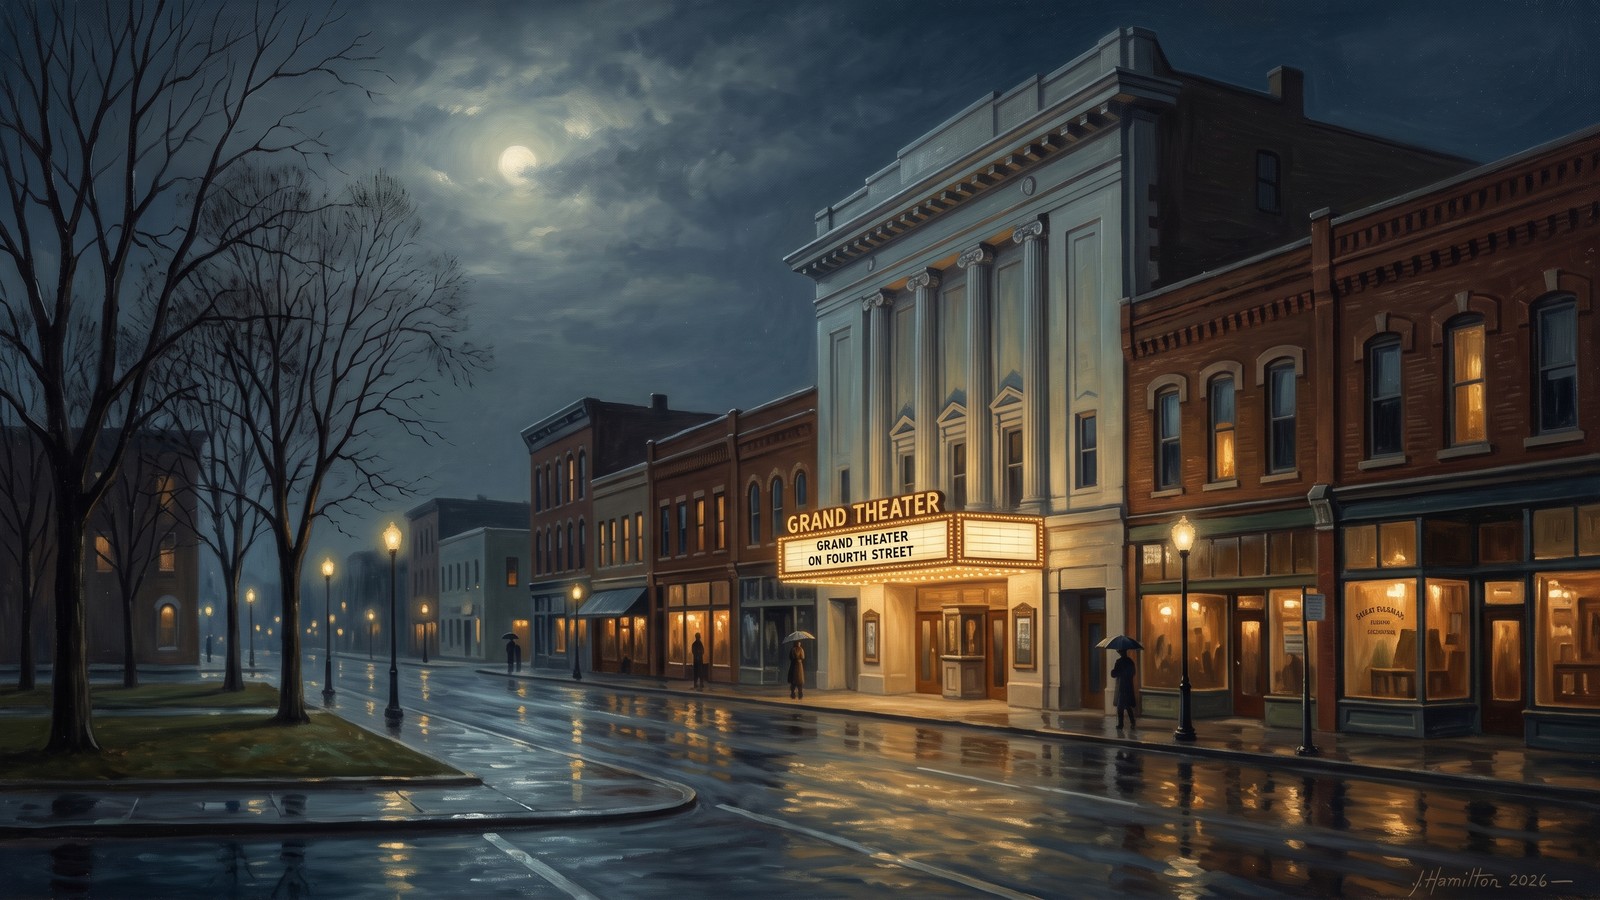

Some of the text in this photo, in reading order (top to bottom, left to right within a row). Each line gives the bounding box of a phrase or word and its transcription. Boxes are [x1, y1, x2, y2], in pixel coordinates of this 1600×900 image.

[787, 492, 940, 534] GRAND THEATER
[816, 531, 909, 551] GRAND THEATER
[808, 545, 914, 566] ON FOURTH STREET
[1509, 873, 1547, 888] 2026
